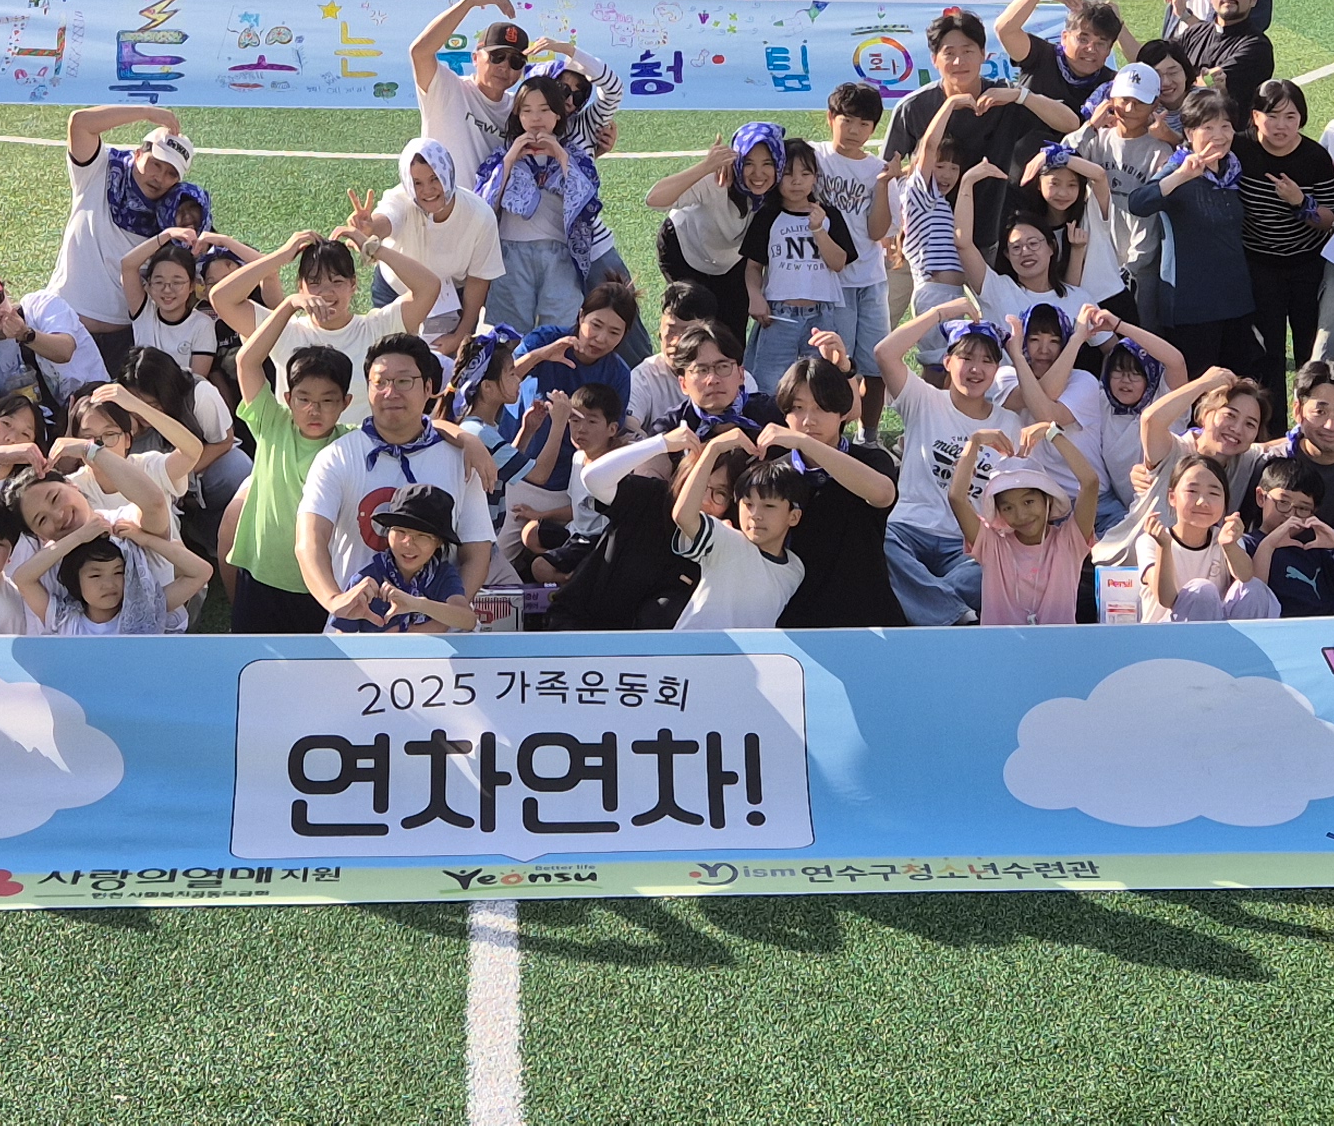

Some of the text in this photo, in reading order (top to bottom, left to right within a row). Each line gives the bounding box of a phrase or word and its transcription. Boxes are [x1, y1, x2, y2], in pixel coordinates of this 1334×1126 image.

[779, 261, 802, 272] NEW
[1107, 578, 1133, 588] Persil
[357, 670, 690, 716] 2025 가족운동회
[287, 728, 767, 837] 연차연차!
[38, 866, 342, 891] 사랑의열매 지원
[441, 867, 598, 891] Yeonsu
[801, 858, 1101, 883] 연수구청소년수련관
